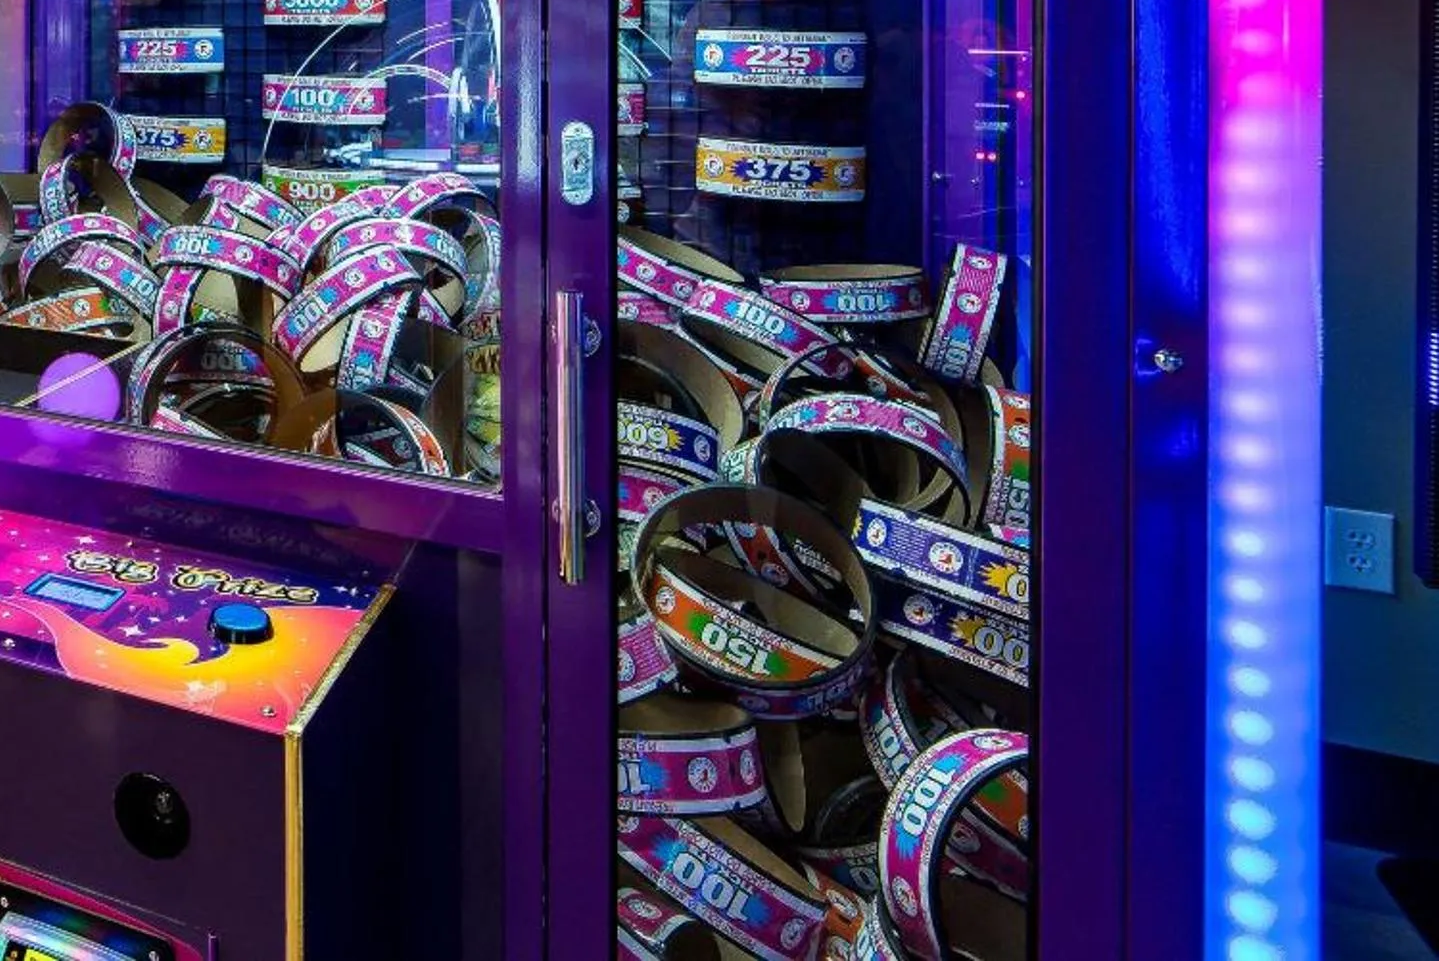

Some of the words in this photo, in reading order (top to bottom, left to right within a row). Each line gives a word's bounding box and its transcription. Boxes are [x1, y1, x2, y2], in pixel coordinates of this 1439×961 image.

[137, 39, 177, 56] 225
[746, 45, 811, 67] 225
[292, 88, 336, 107] 100
[136, 127, 175, 146] 375
[746, 158, 811, 181] 375
[288, 181, 336, 201] 900
[837, 292, 888, 312] 100
[736, 300, 786, 335] 100
[67, 551, 158, 585] Big
[172, 566, 319, 603] Prize
[701, 622, 771, 676] 150
[974, 626, 1029, 668] 00
[903, 768, 955, 836] 100
[671, 849, 756, 923] 100
